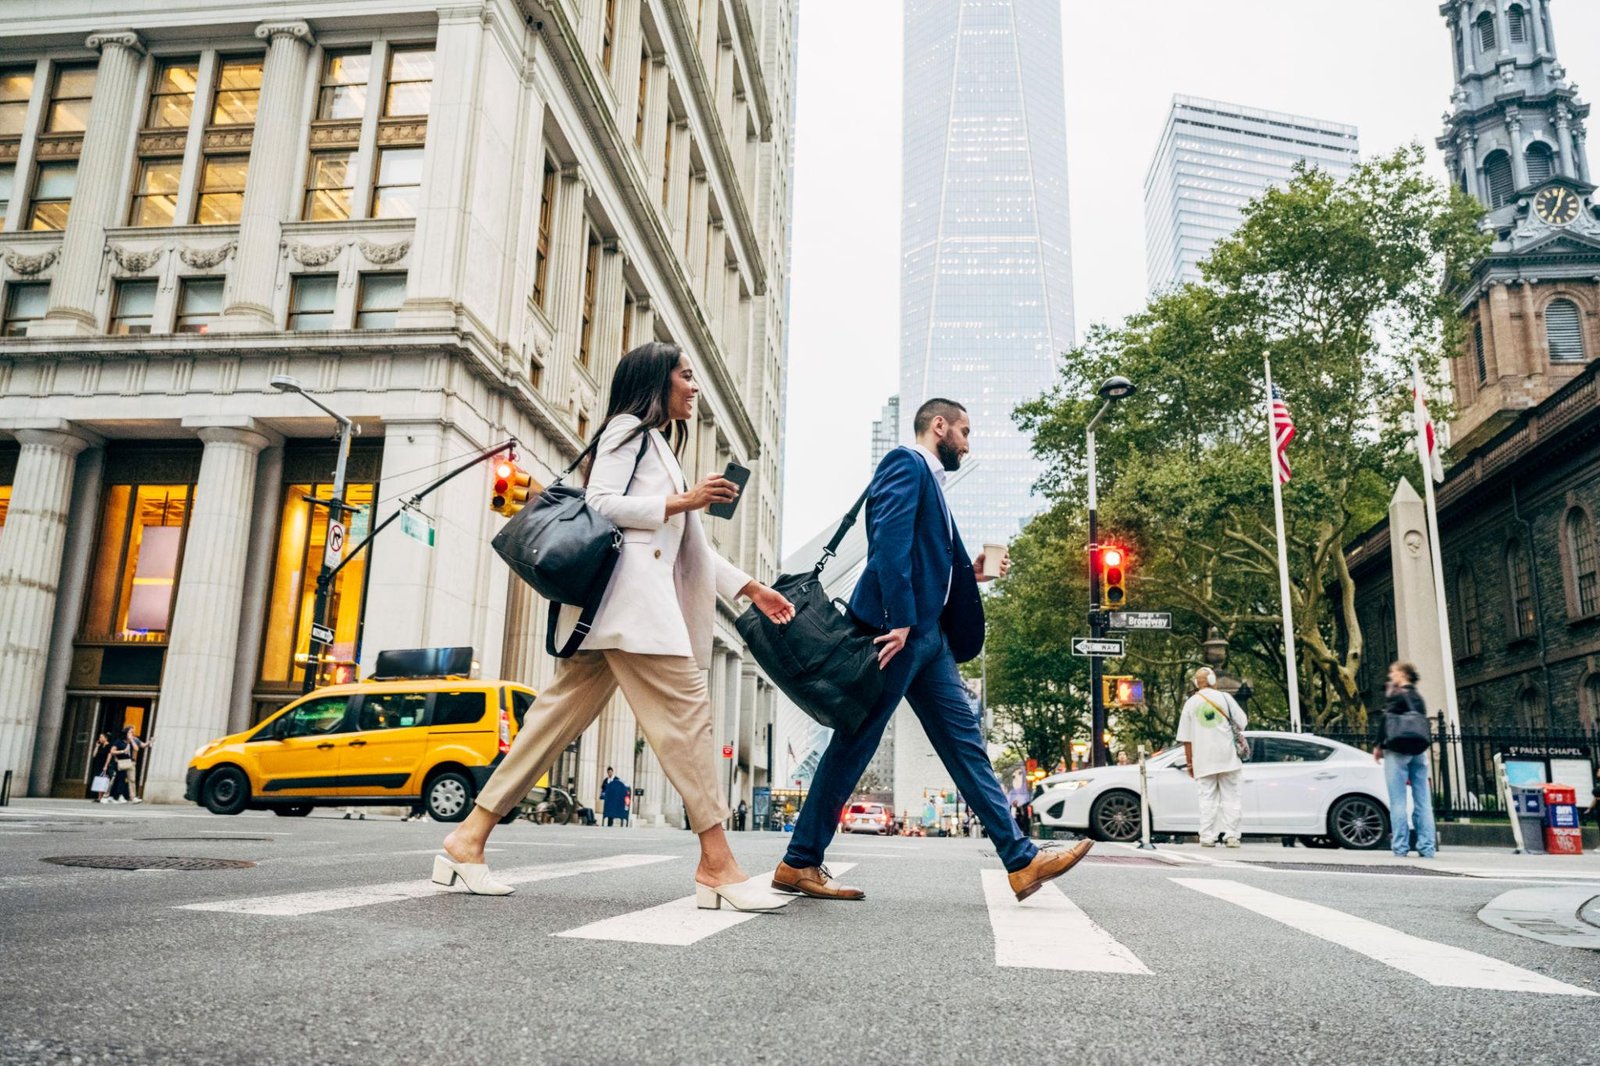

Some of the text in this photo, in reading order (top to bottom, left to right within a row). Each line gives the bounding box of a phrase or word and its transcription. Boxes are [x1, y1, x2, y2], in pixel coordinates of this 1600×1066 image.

[1128, 616, 1168, 627] Broadway
[1080, 642, 1094, 651] ONE
[1548, 747, 1583, 756] CHAPEL
